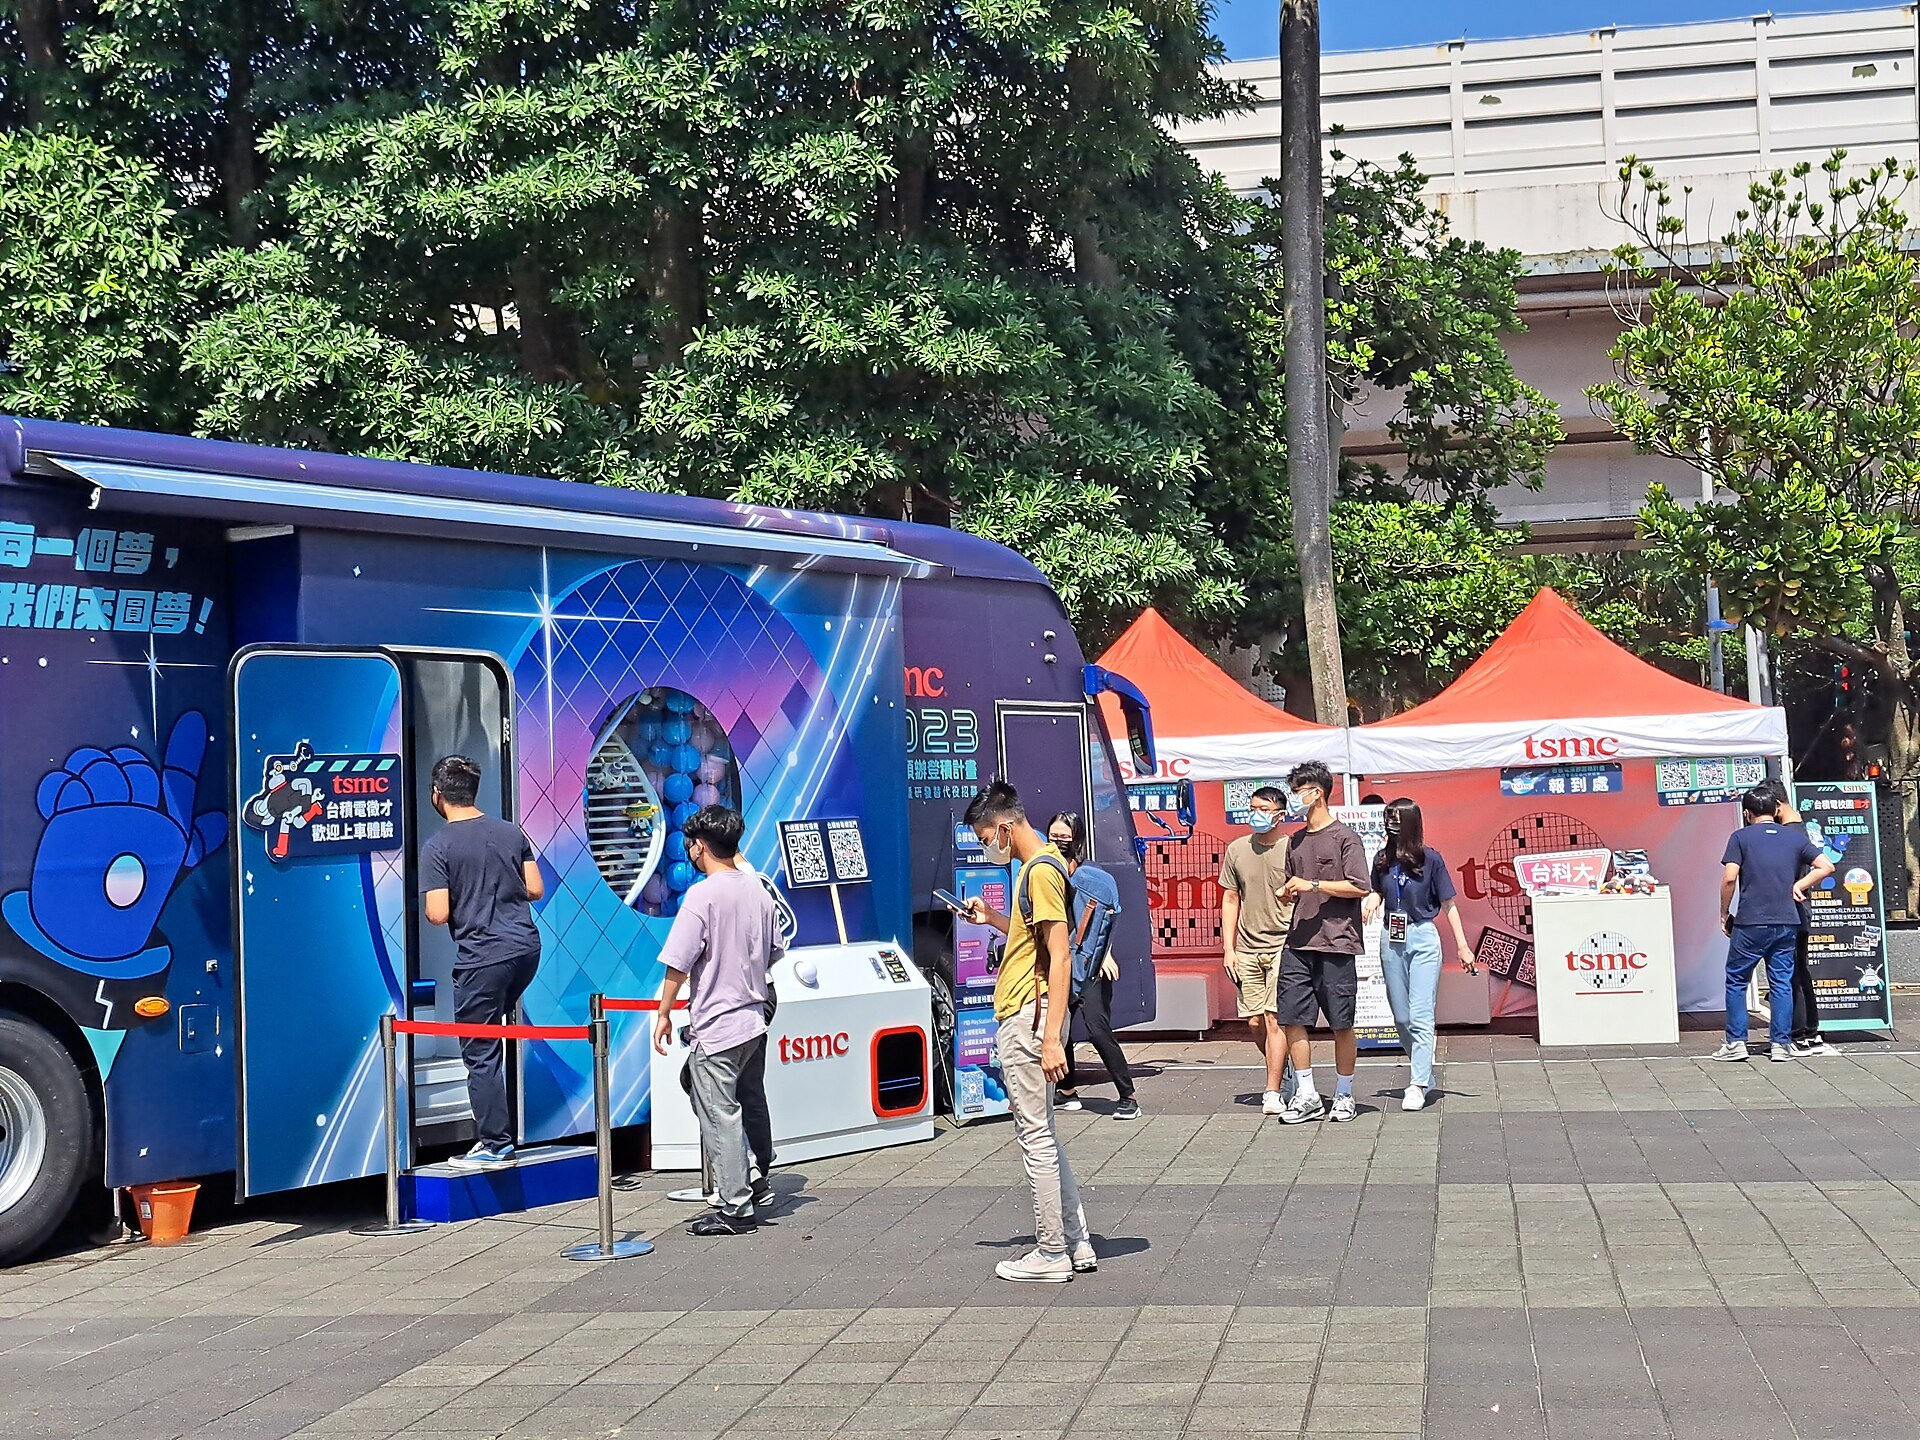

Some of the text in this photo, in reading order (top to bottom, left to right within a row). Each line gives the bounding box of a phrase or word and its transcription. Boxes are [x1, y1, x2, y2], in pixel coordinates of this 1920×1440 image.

[1523, 735, 1620, 760] tsmc
[332, 774, 390, 795] tsmc
[1548, 776, 1610, 794] 報到處
[326, 800, 393, 820] 台積電徵才
[311, 822, 394, 843] 歡迎上車體驗
[1531, 861, 1594, 884] 台科大
[1564, 950, 1648, 972] tsmc
[777, 1030, 850, 1065] tsmc
